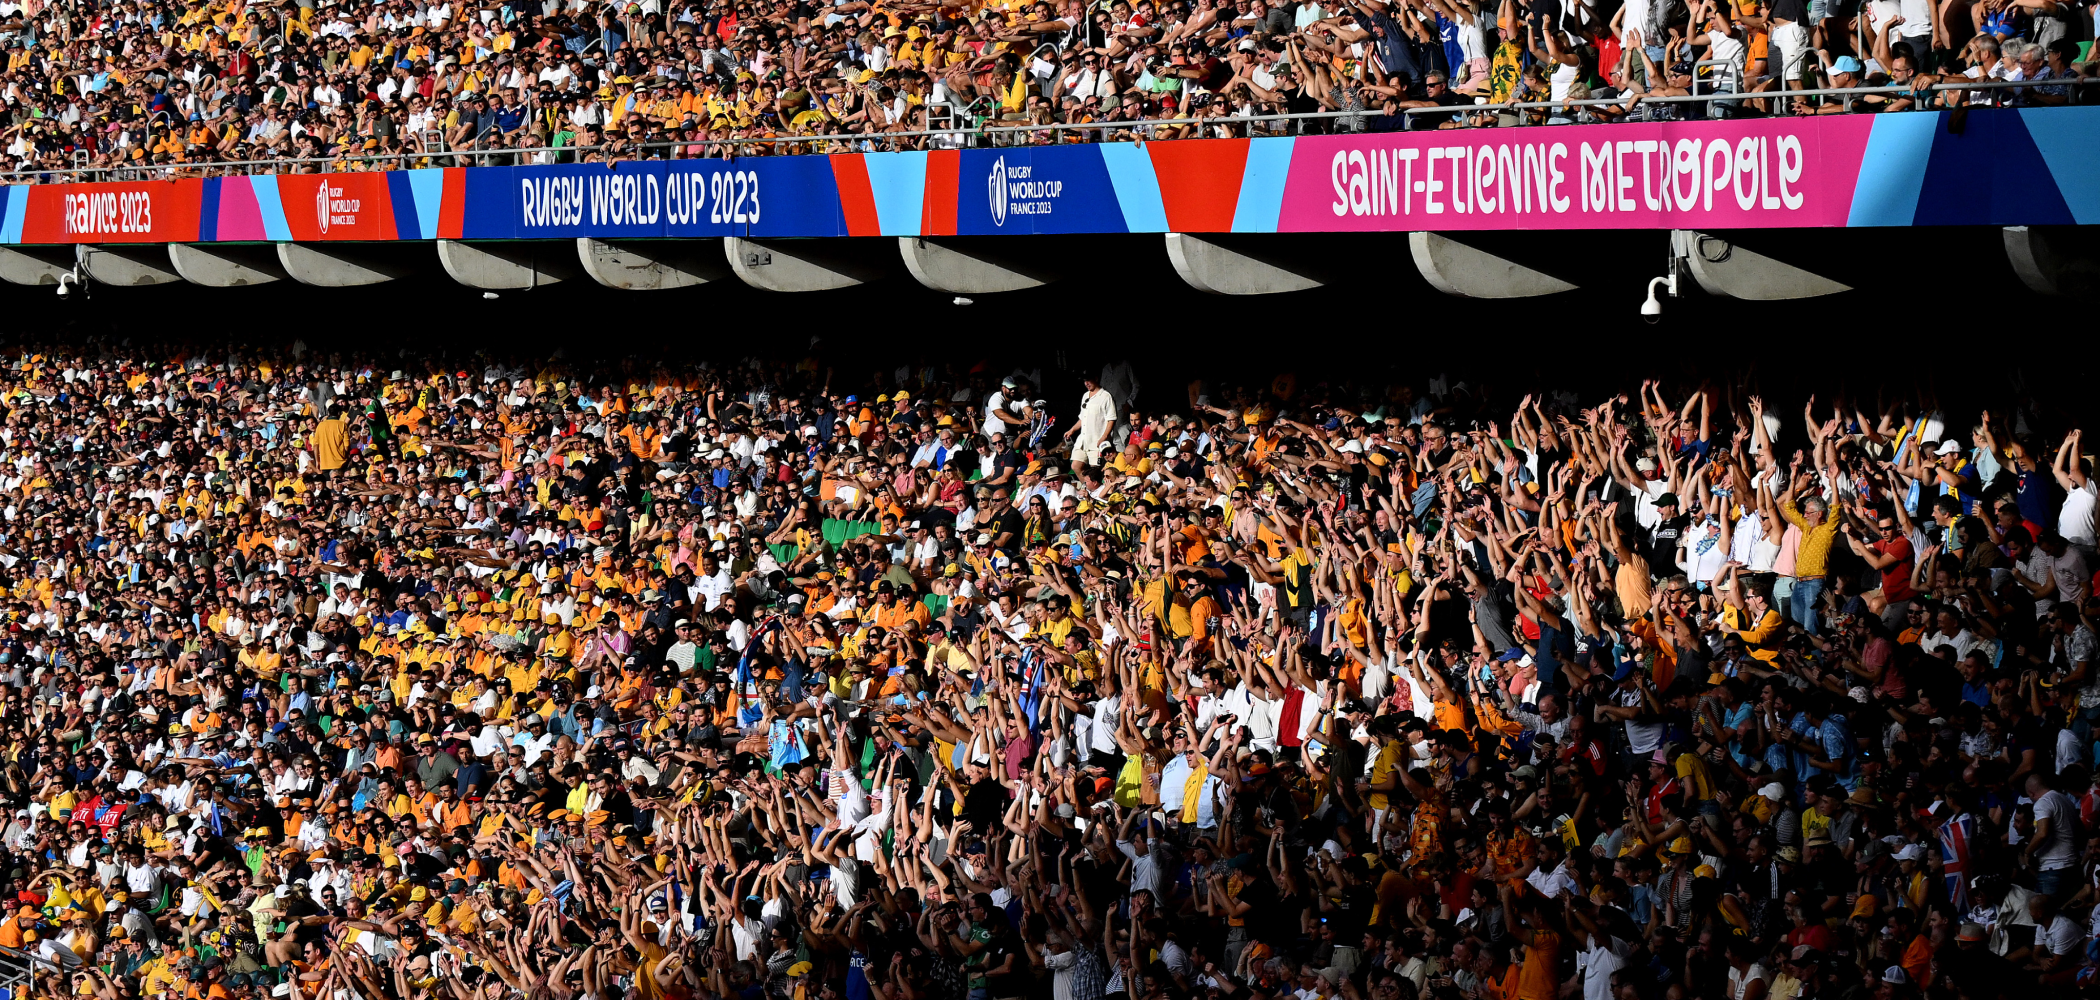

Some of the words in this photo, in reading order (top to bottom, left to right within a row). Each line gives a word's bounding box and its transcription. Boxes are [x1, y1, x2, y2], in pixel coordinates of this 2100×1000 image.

[1008, 166, 1031, 179] RUGBY
[1009, 181, 1044, 199] WORLD
[1045, 180, 1062, 198] CUP
[330, 199, 350, 213] WORLD
[351, 199, 361, 212] CUP
[522, 175, 584, 227] RUGBY
[590, 173, 660, 225] WORLD
[666, 172, 706, 225] CUP
[711, 170, 760, 224] 2023
[120, 191, 151, 233] 2023
[1011, 202, 1035, 214] FRANCE
[1036, 201, 1052, 214] 2023
